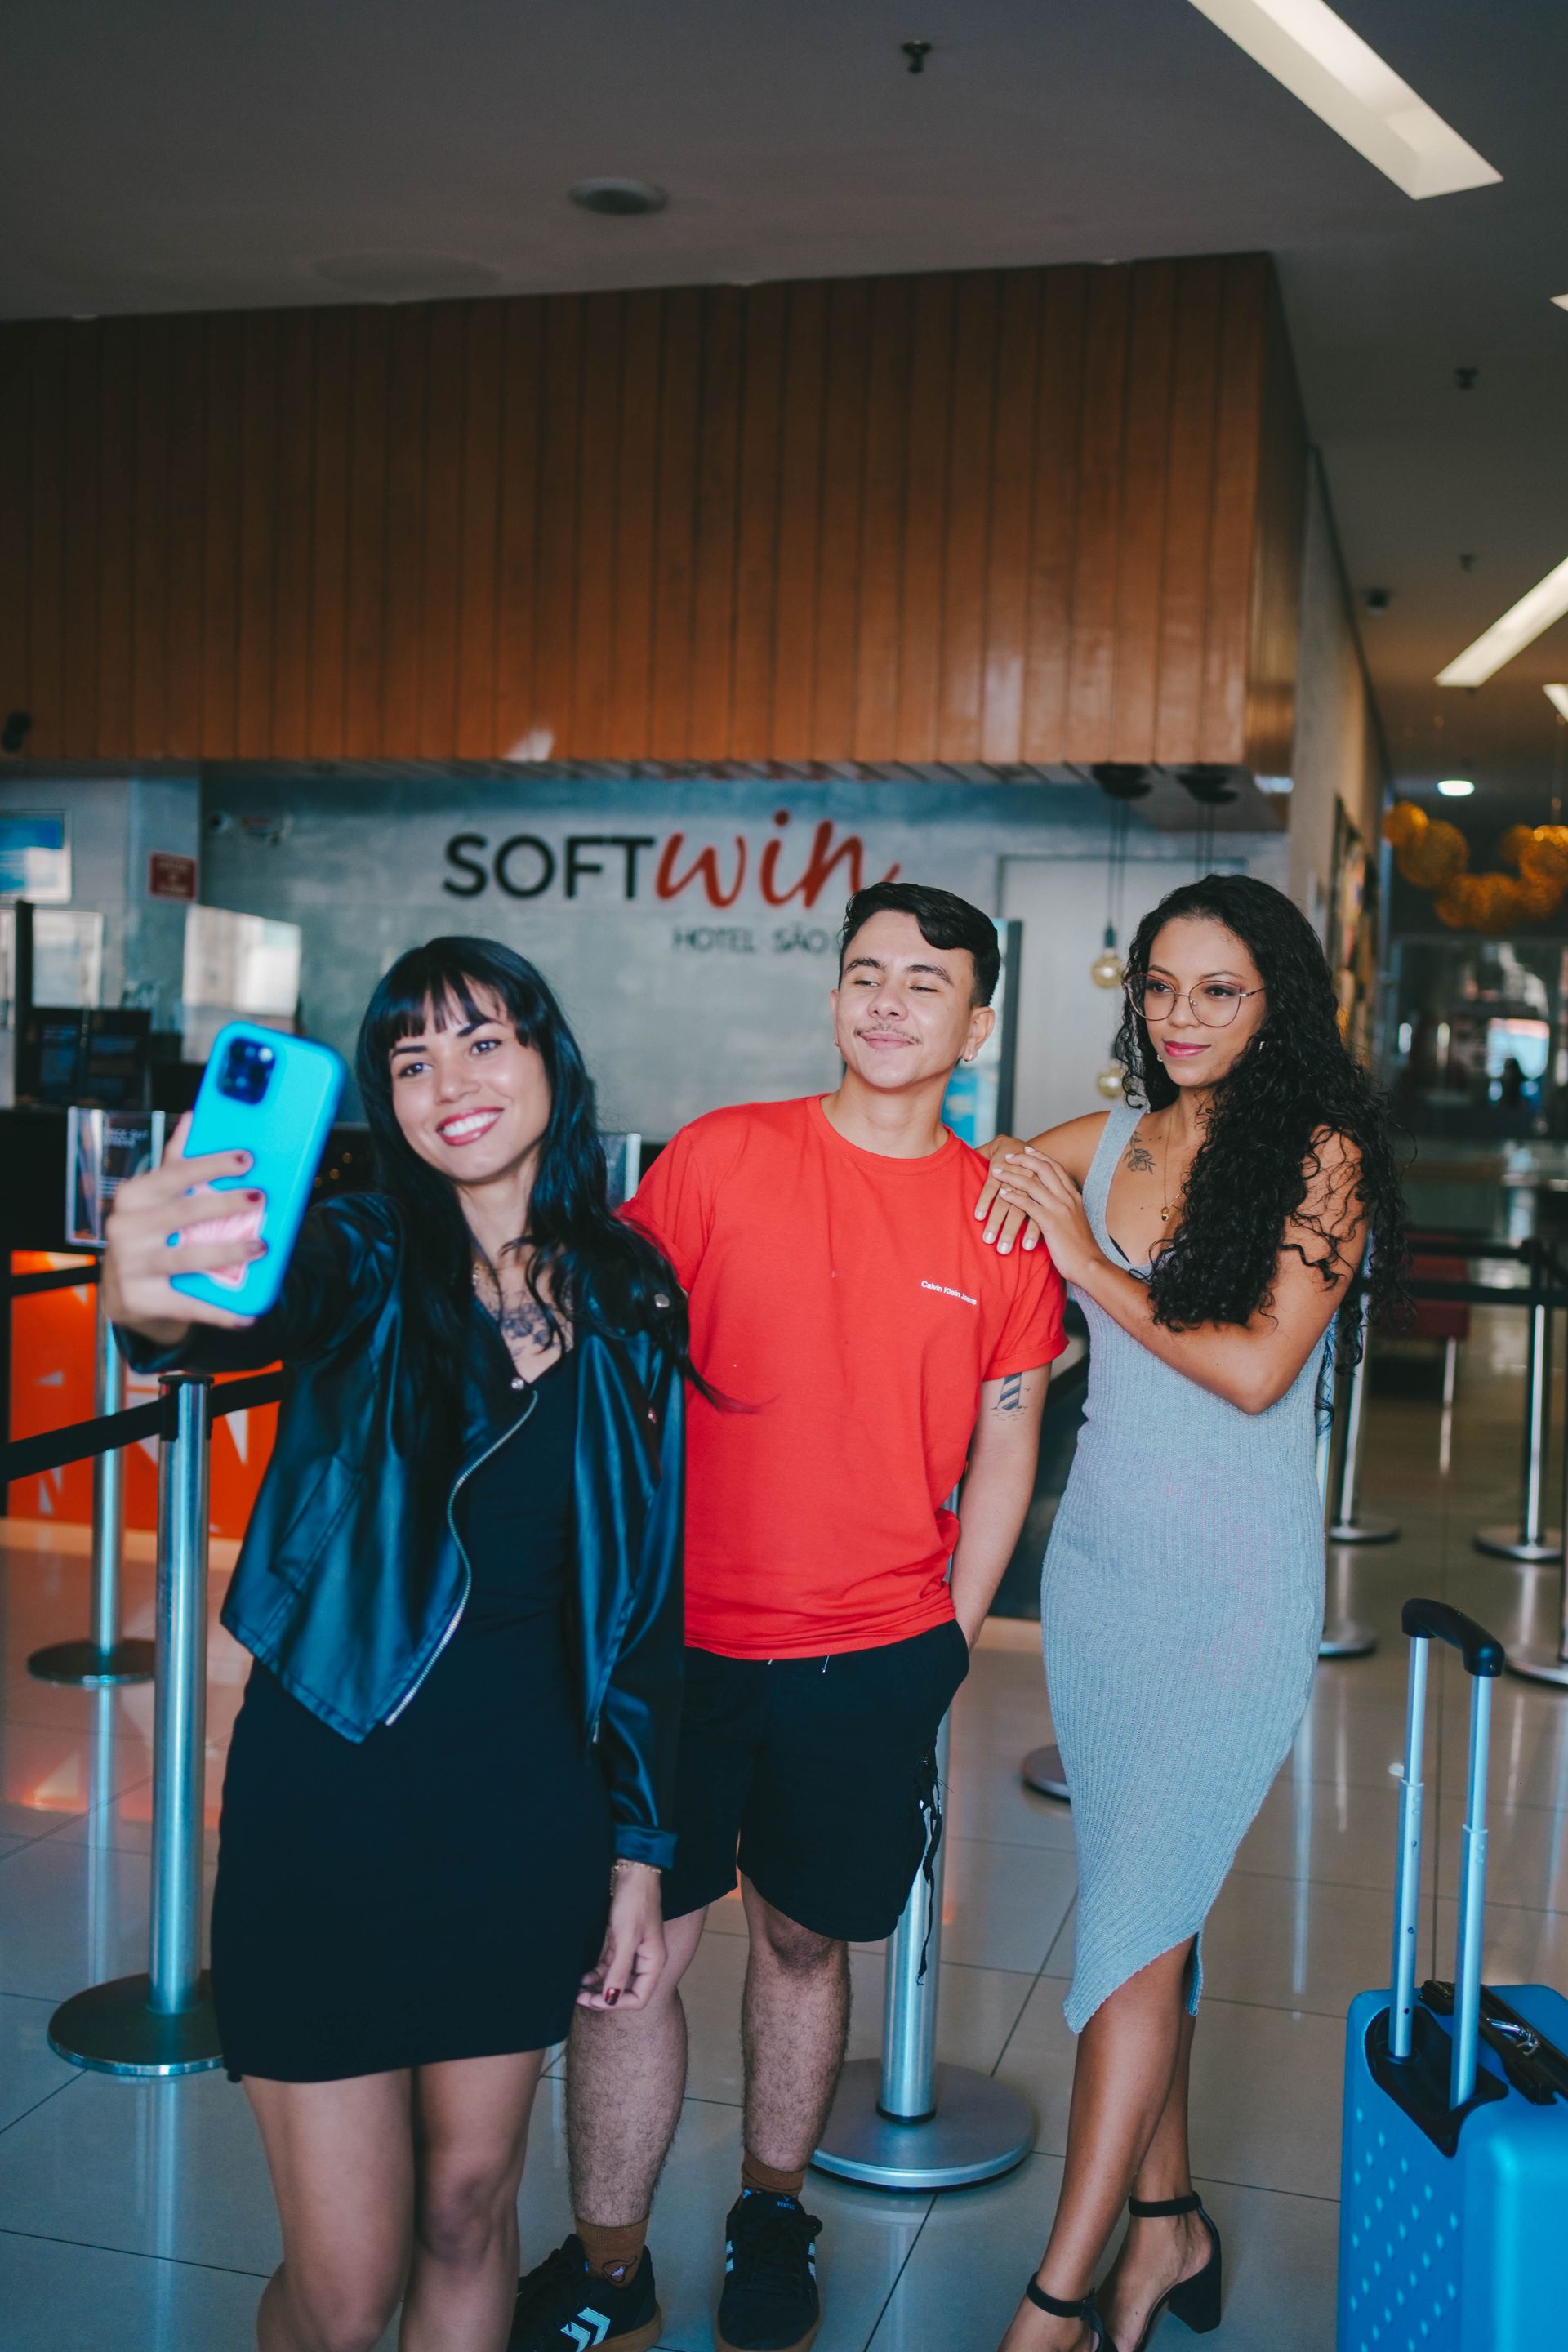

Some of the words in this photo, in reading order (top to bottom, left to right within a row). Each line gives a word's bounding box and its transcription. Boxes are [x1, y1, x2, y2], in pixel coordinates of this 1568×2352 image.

[672, 926, 755, 954] HOTEL
[773, 921, 831, 954] SÃO
[921, 1281, 942, 1292] Calvin
[944, 1287, 960, 1297] Klein
